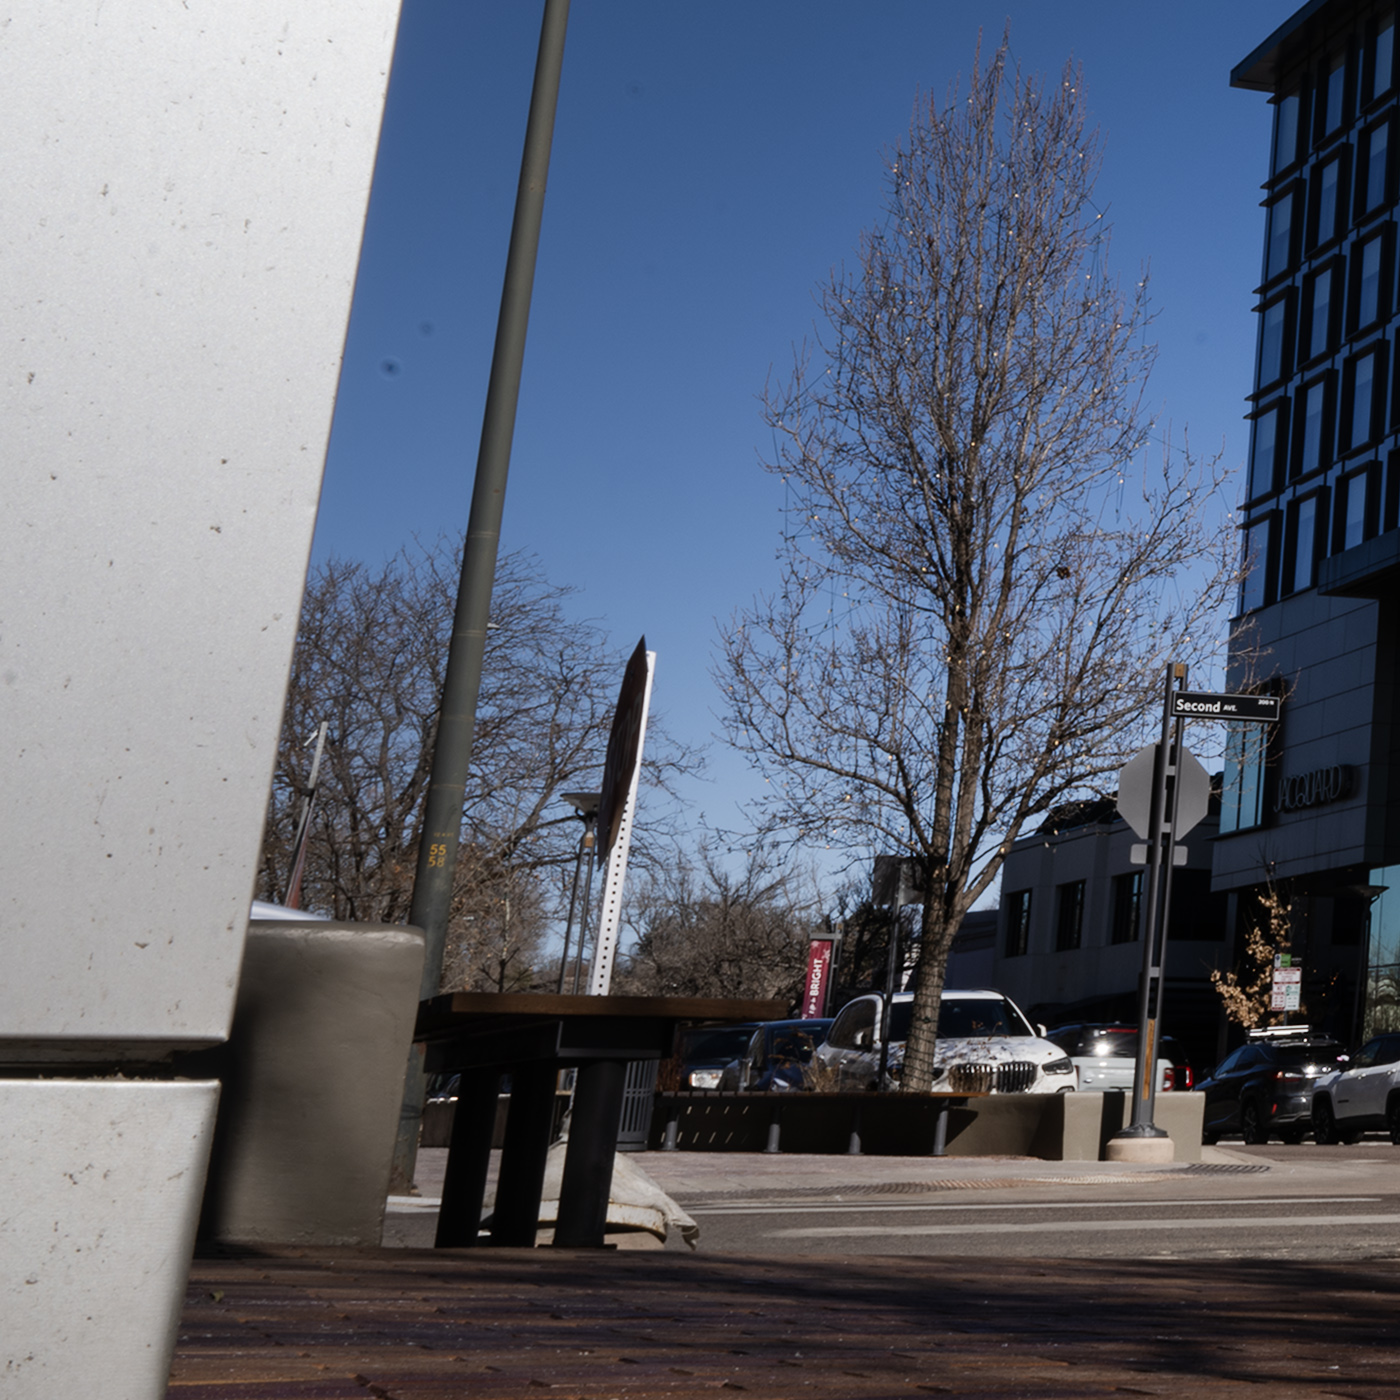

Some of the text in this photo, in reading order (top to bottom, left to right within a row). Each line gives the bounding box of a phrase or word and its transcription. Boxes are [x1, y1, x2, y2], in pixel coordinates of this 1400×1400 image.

[1176, 698, 1238, 713] Second AVE.
[1272, 763, 1342, 813] JACQUARD
[429, 843, 447, 856] 55
[428, 856, 445, 868] 58
[809, 958, 824, 997] BRIGHT
